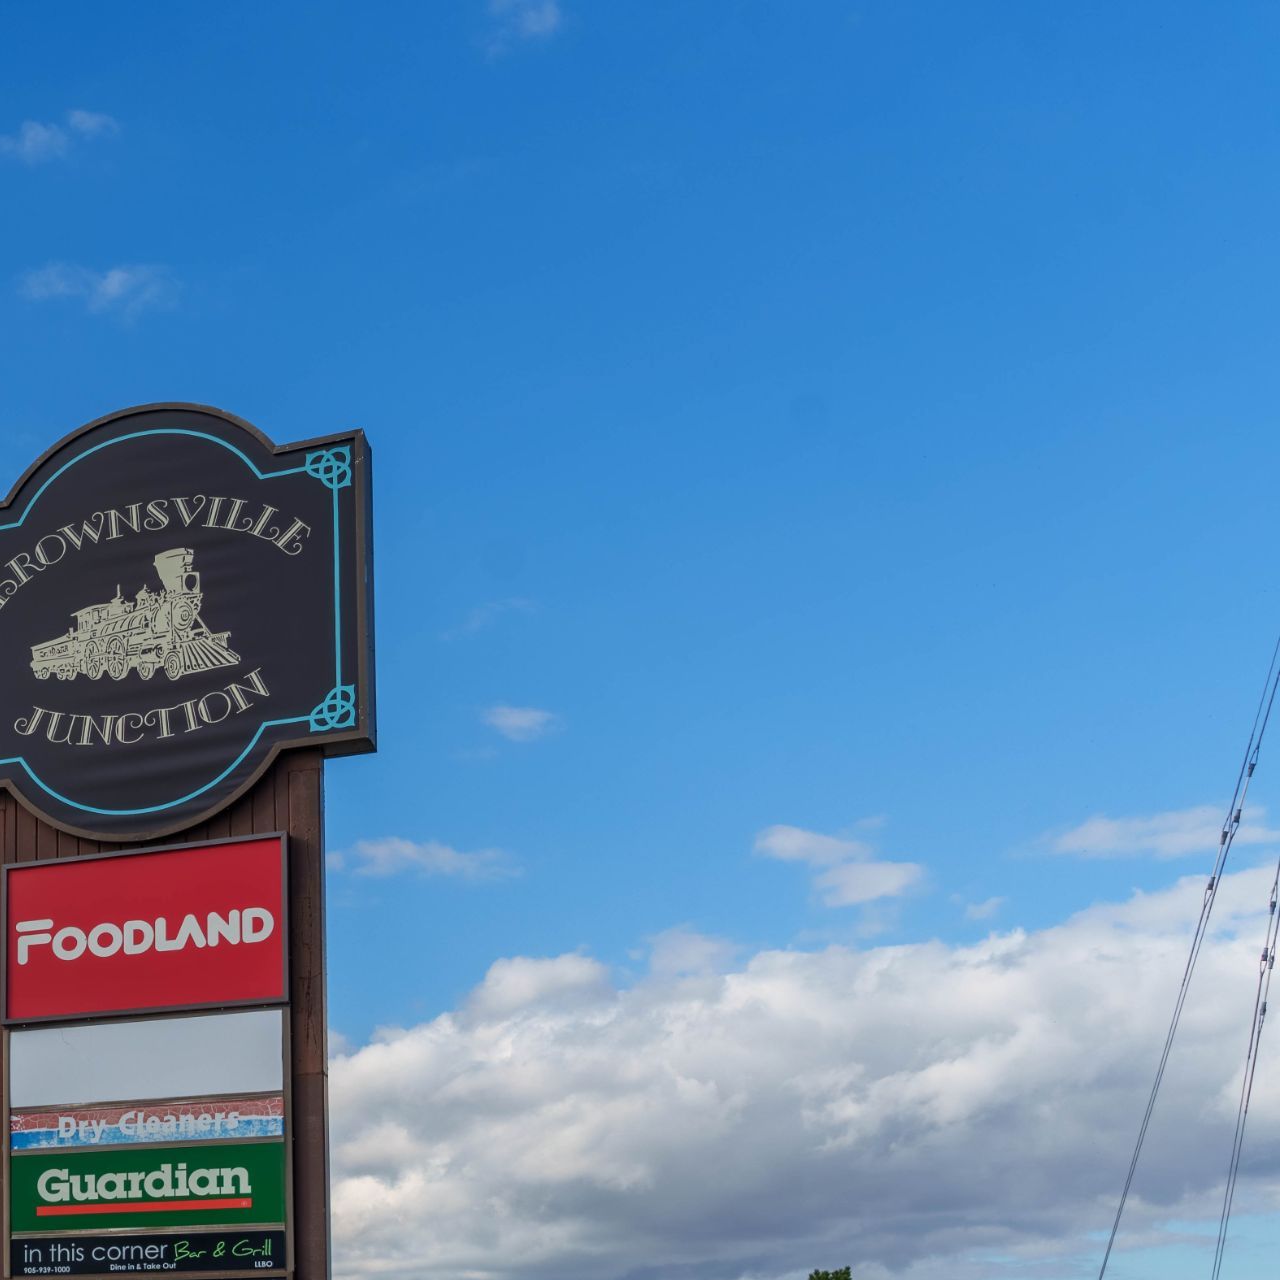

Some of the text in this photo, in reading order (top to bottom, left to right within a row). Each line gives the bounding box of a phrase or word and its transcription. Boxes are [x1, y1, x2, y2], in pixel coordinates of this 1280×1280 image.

[13, 667, 271, 746] JUNCTION
[15, 907, 275, 966] FOODLAND
[58, 1109, 240, 1144] Dry Cleaners
[36, 1163, 252, 1202] Guardian
[23, 1238, 272, 1263] in this corner Bar & Grill
[254, 1260, 273, 1268] LLBO
[23, 1265, 71, 1274] 905-939-1000
[110, 1263, 127, 1271] Dine
[143, 1262, 161, 1270] Take
[162, 1261, 177, 1269] Out
